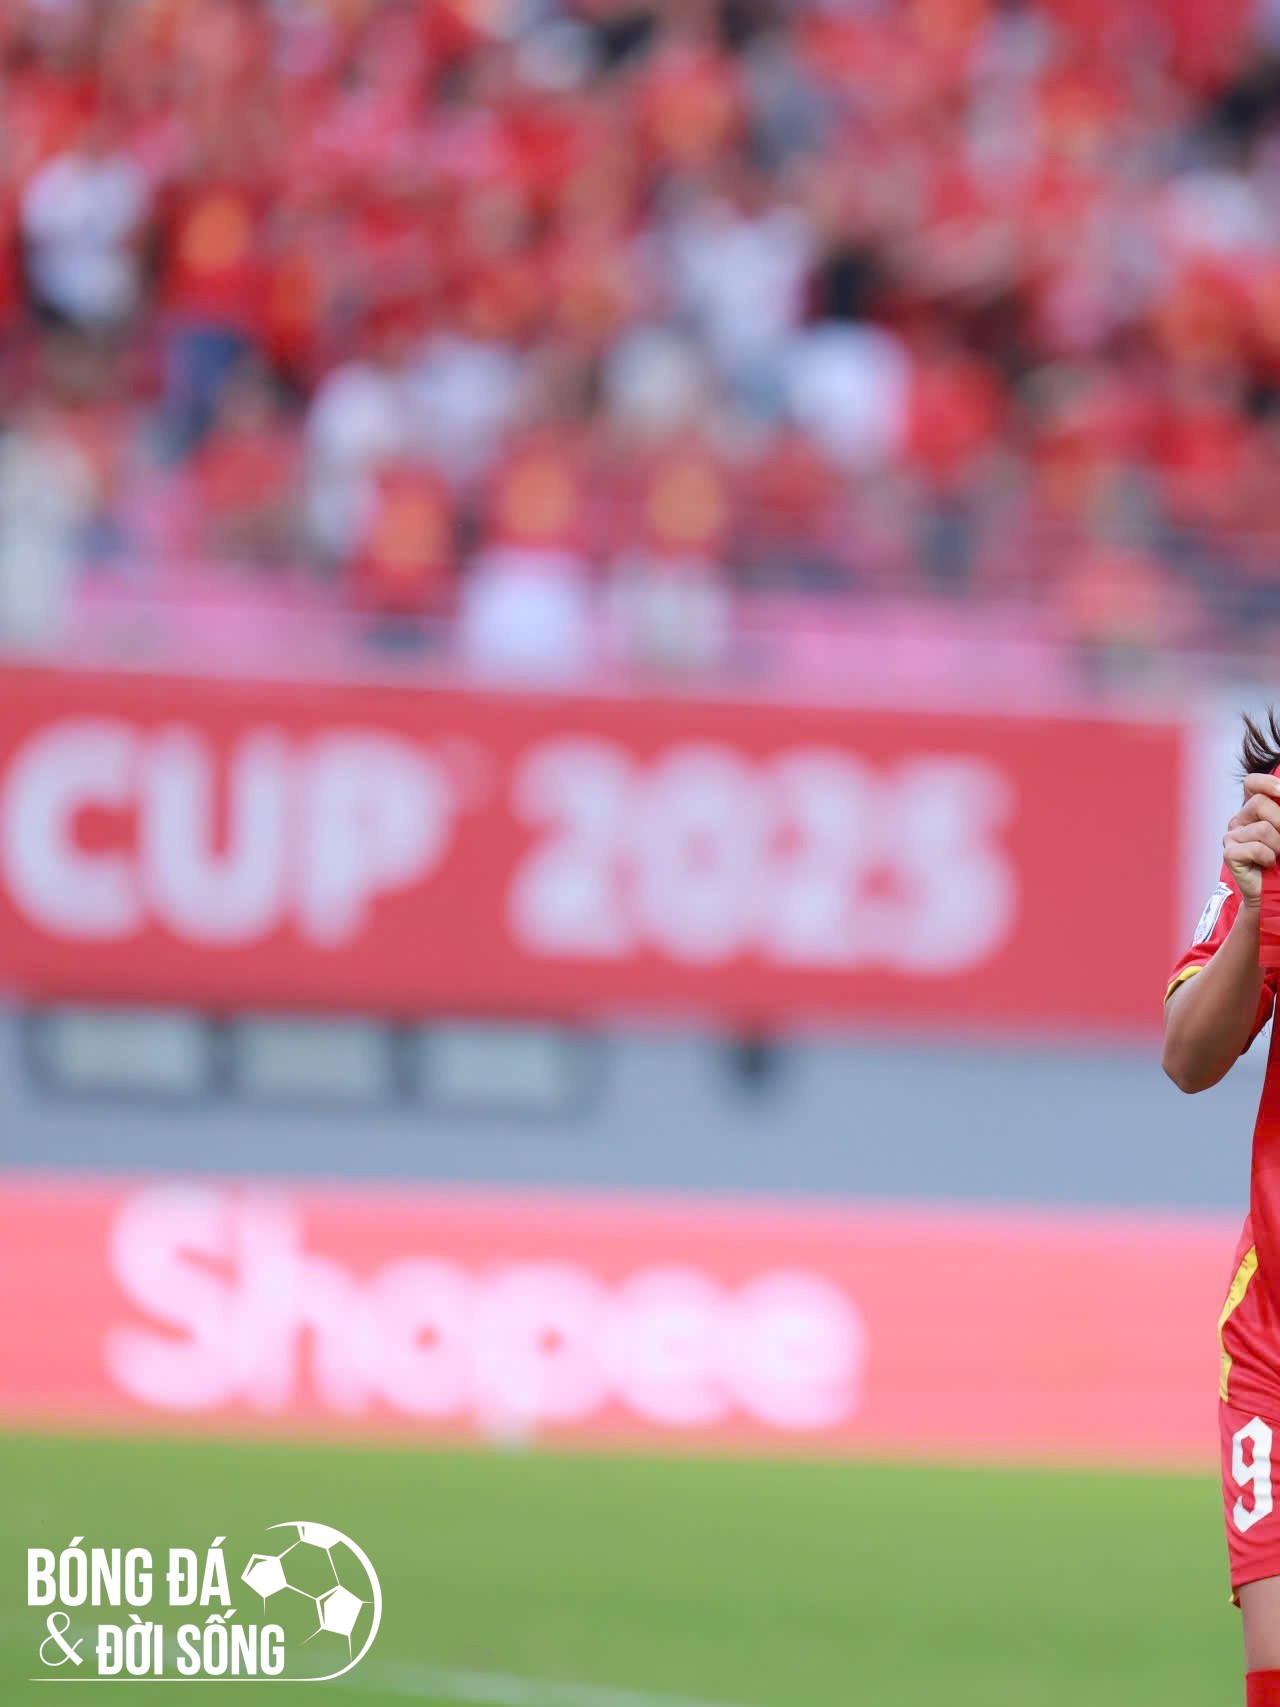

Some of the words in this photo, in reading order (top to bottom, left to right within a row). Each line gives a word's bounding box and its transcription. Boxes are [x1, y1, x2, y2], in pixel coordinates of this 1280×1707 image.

[2, 724, 452, 940] CUP
[514, 740, 1012, 972] 2025
[106, 1186, 864, 1446] Shopee
[1231, 1415, 1274, 1534] 9
